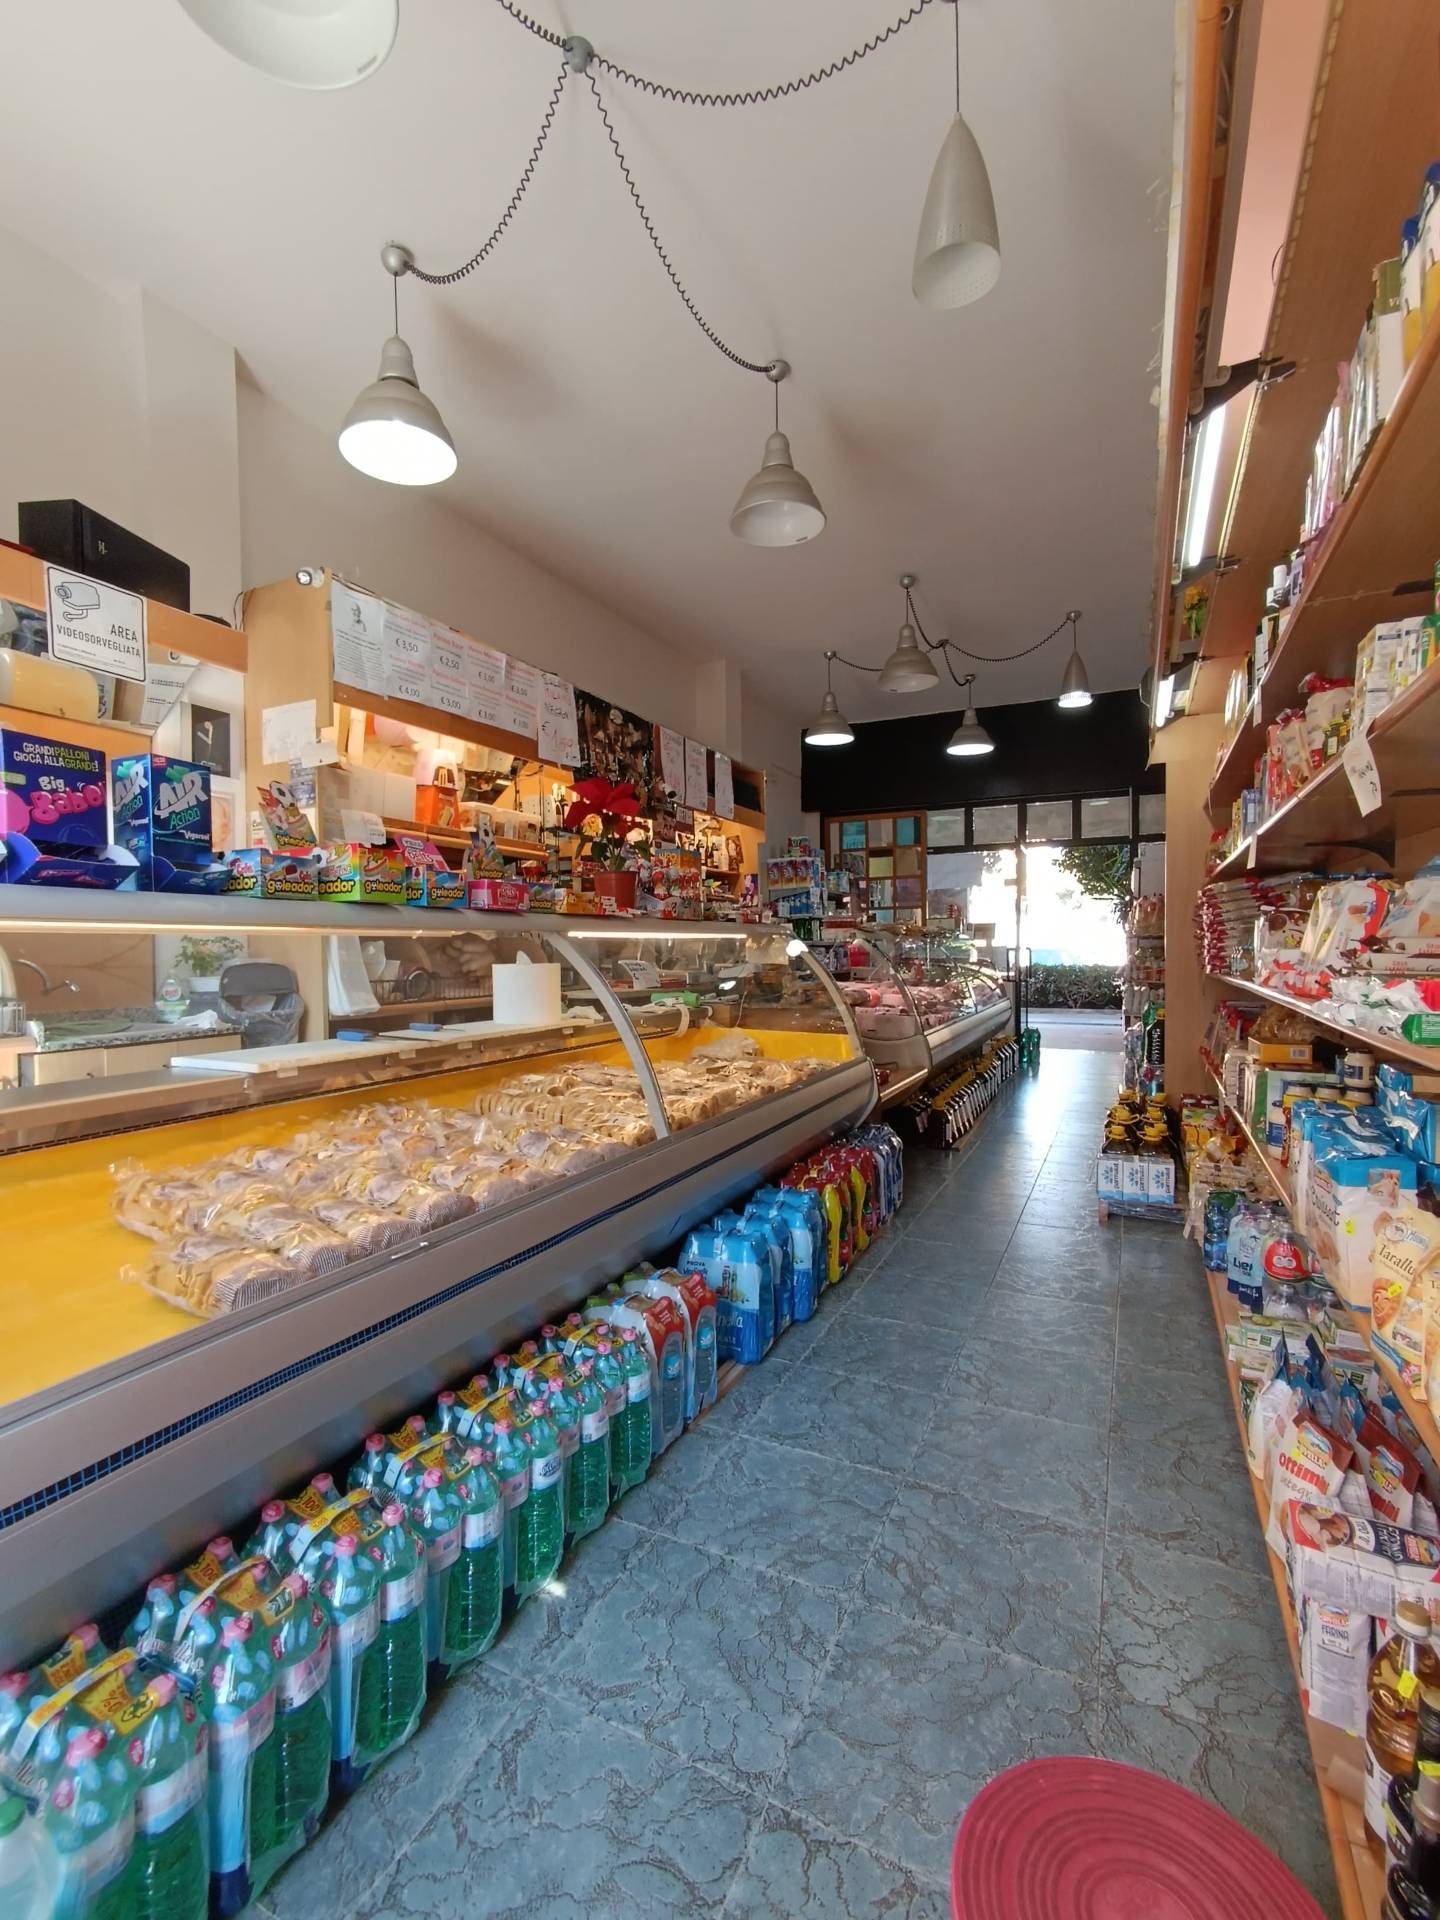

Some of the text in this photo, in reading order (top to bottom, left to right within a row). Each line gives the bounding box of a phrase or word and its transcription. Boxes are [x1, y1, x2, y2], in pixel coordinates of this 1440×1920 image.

[56, 624, 141, 658] VIDEOSORVEGLIATA
[110, 623, 138, 642] AREA
[13, 751, 42, 764] GIOCA
[44, 754, 65, 767] ALLA
[23, 742, 90, 761] GRANDI PALLONI
[38, 775, 65, 792] Big
[156, 774, 209, 820] AIR
[169, 806, 200, 830] Action
[267, 879, 314, 894] goleador
[365, 879, 402, 893] goleador
[431, 887, 465, 899] goleador
[1321, 1624, 1350, 1640] FARINA
